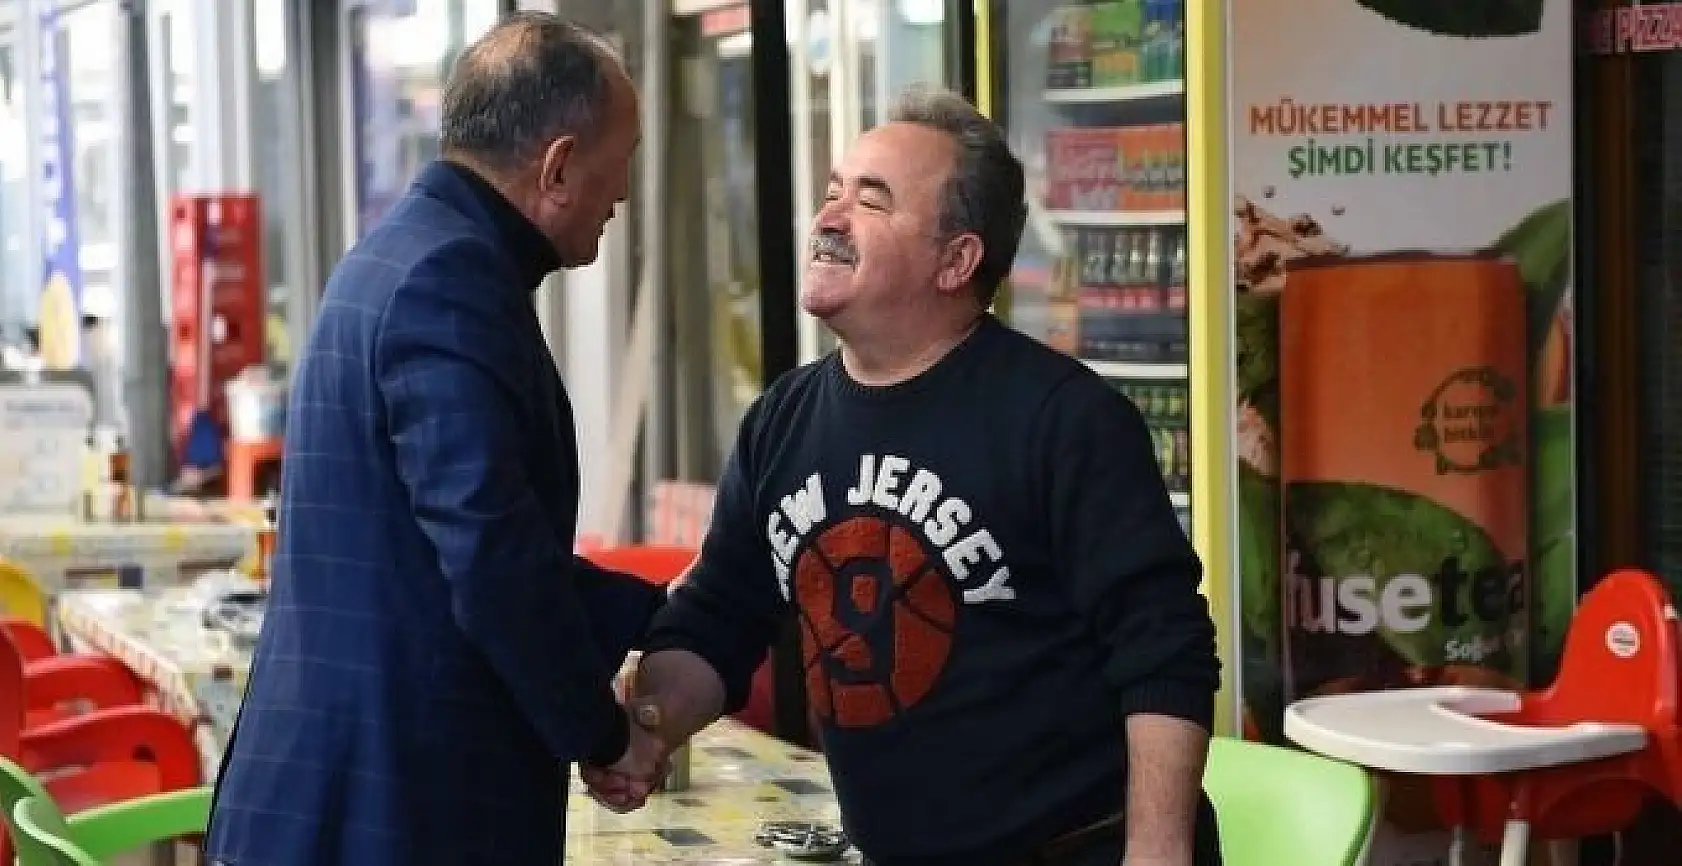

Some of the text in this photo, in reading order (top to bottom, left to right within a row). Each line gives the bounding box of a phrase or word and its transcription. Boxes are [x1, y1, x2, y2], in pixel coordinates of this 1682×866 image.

[1249, 97, 1553, 135] MÜKEMMEL LEZZET
[1288, 138, 1512, 178] ŞİMDİ KEŞFET!
[847, 453, 1017, 604] JERSEY
[822, 557, 894, 685] 9
